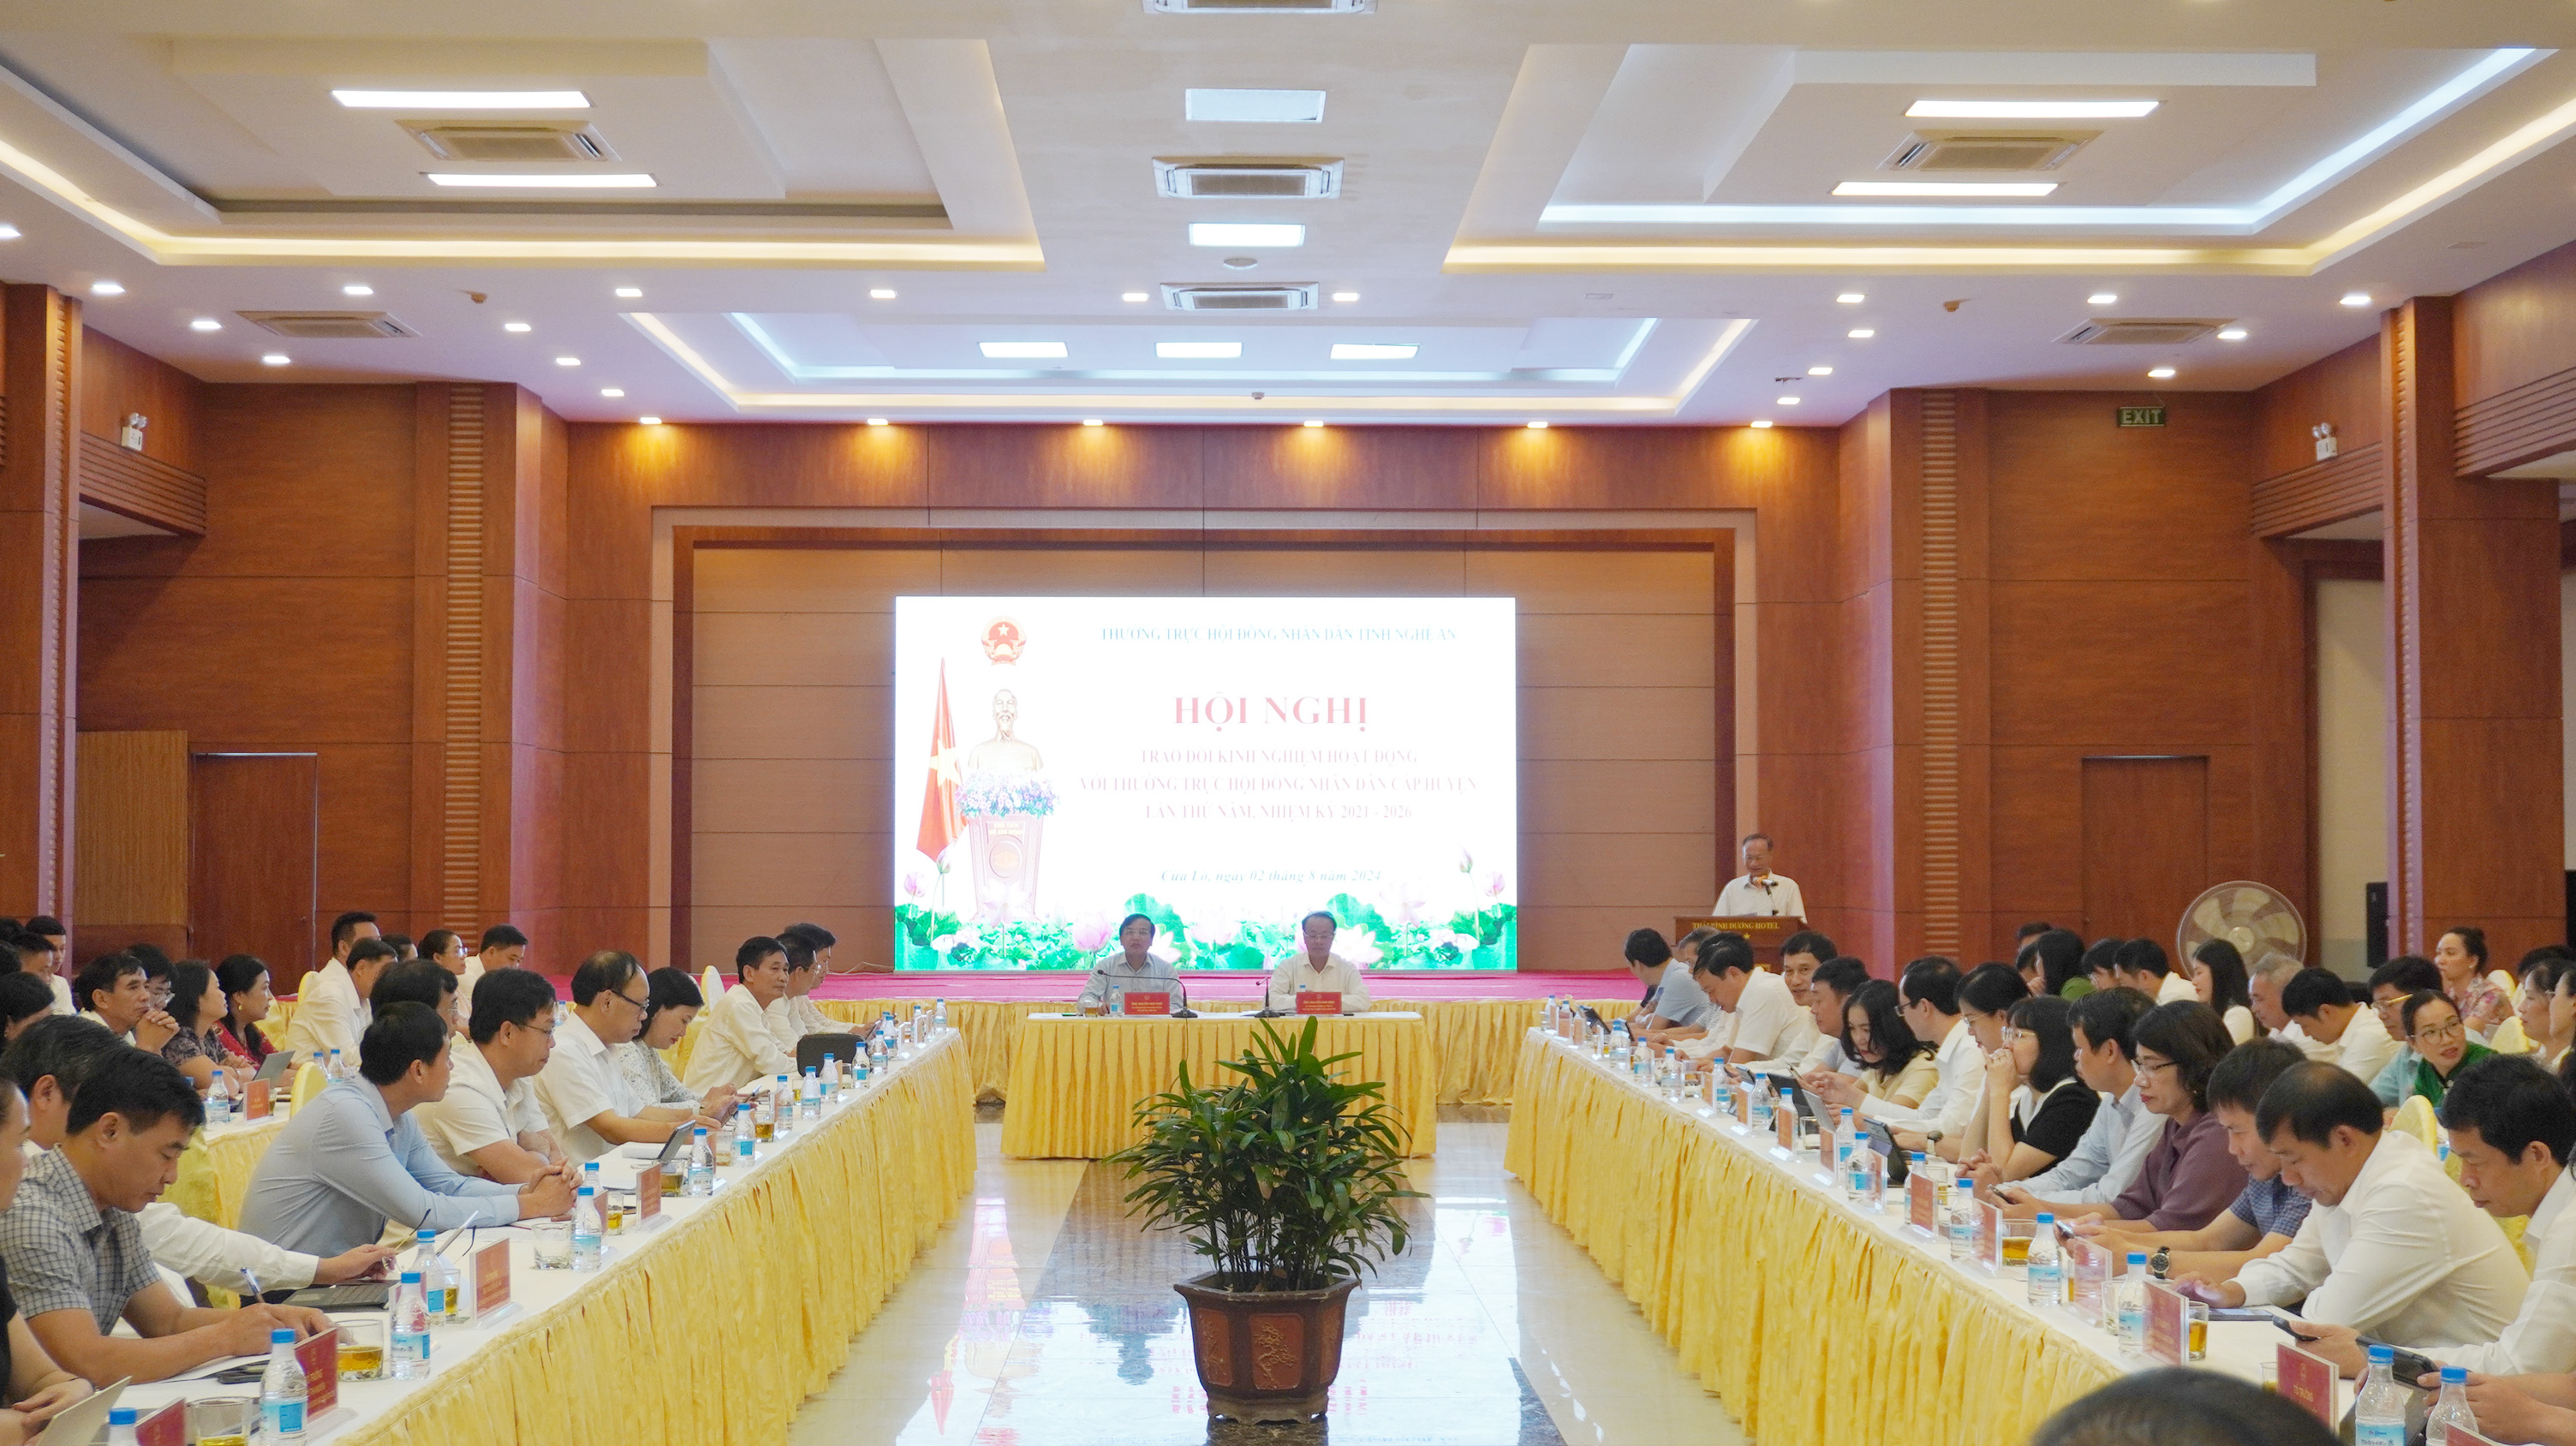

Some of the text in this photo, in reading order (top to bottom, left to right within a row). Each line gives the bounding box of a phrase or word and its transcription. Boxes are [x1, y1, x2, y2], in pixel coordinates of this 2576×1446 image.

[2123, 409, 2162, 424] EXIT
[1439, 628, 1456, 641] AN
[1173, 691, 1368, 732] HỘI NGHỊ
[1140, 750, 1181, 763] TRAO
[1219, 750, 1255, 763] KINH
[1341, 805, 1369, 818] 2021
[1383, 805, 1413, 818] 2026
[1250, 870, 1265, 881] 02
[1268, 869, 1304, 885] tháng
[1309, 870, 1316, 881] 8
[1351, 870, 1381, 881] 2024
